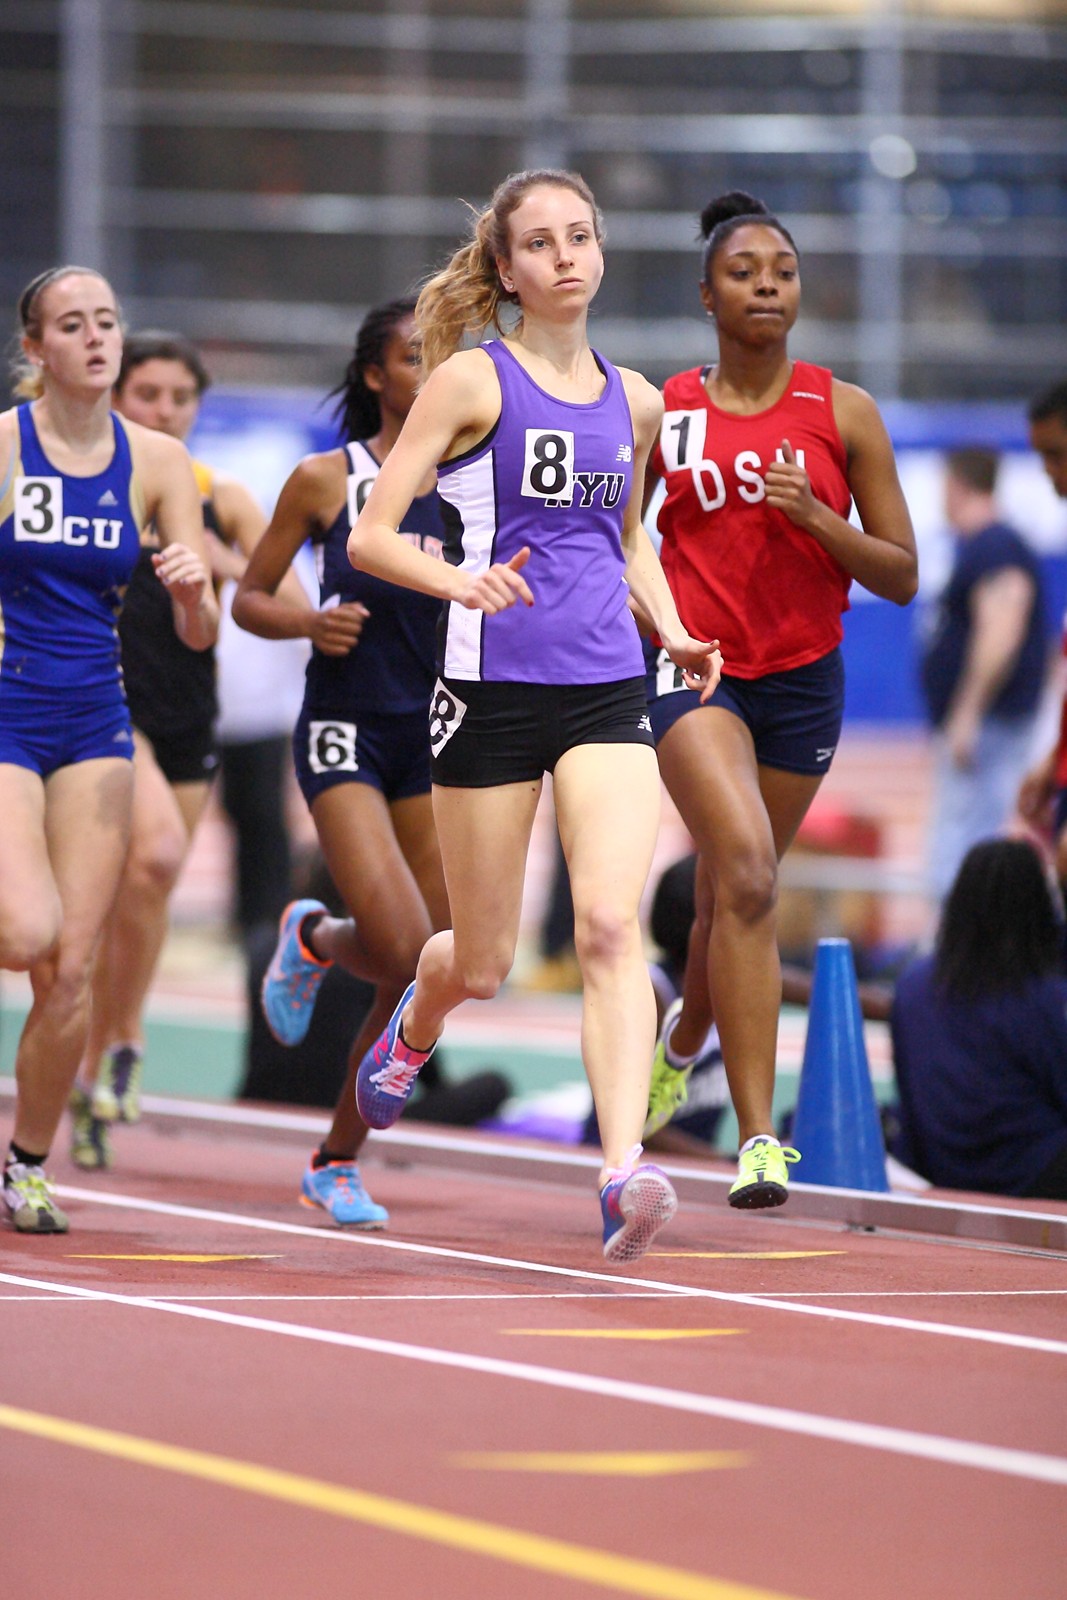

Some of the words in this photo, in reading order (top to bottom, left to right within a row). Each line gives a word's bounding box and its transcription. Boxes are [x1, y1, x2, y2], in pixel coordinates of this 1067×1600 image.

[530, 434, 567, 494] 8
[670, 416, 691, 465] 1
[22, 483, 53, 534] 3
[544, 472, 625, 508] YU
[62, 516, 123, 549] CU
[430, 690, 456, 745] 8
[317, 726, 347, 766] 6
